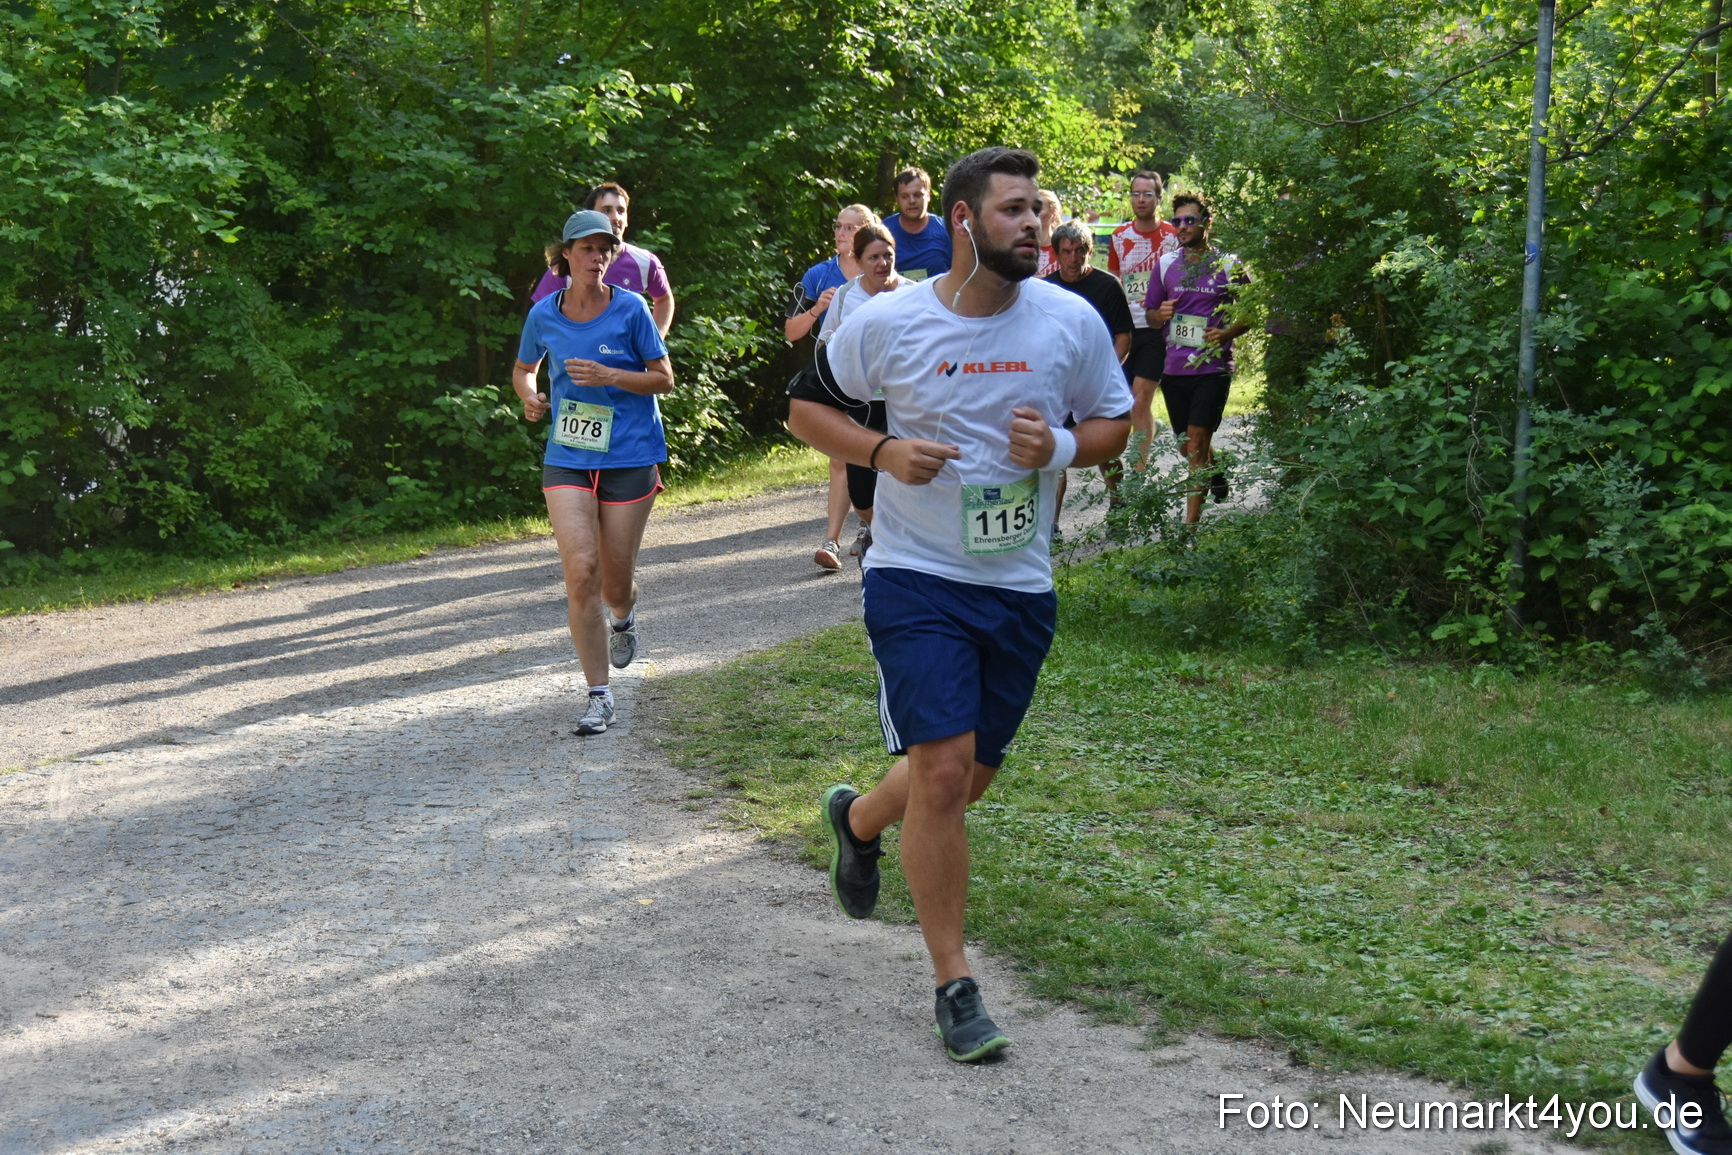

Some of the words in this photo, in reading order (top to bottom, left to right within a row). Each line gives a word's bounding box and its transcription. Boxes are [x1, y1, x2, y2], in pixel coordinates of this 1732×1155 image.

[1175, 324, 1195, 338] 881
[963, 361, 1034, 374] KLEBL
[561, 416, 603, 438] 1078
[975, 498, 1035, 536] 1153
[974, 531, 1022, 544] Ehrensberger
